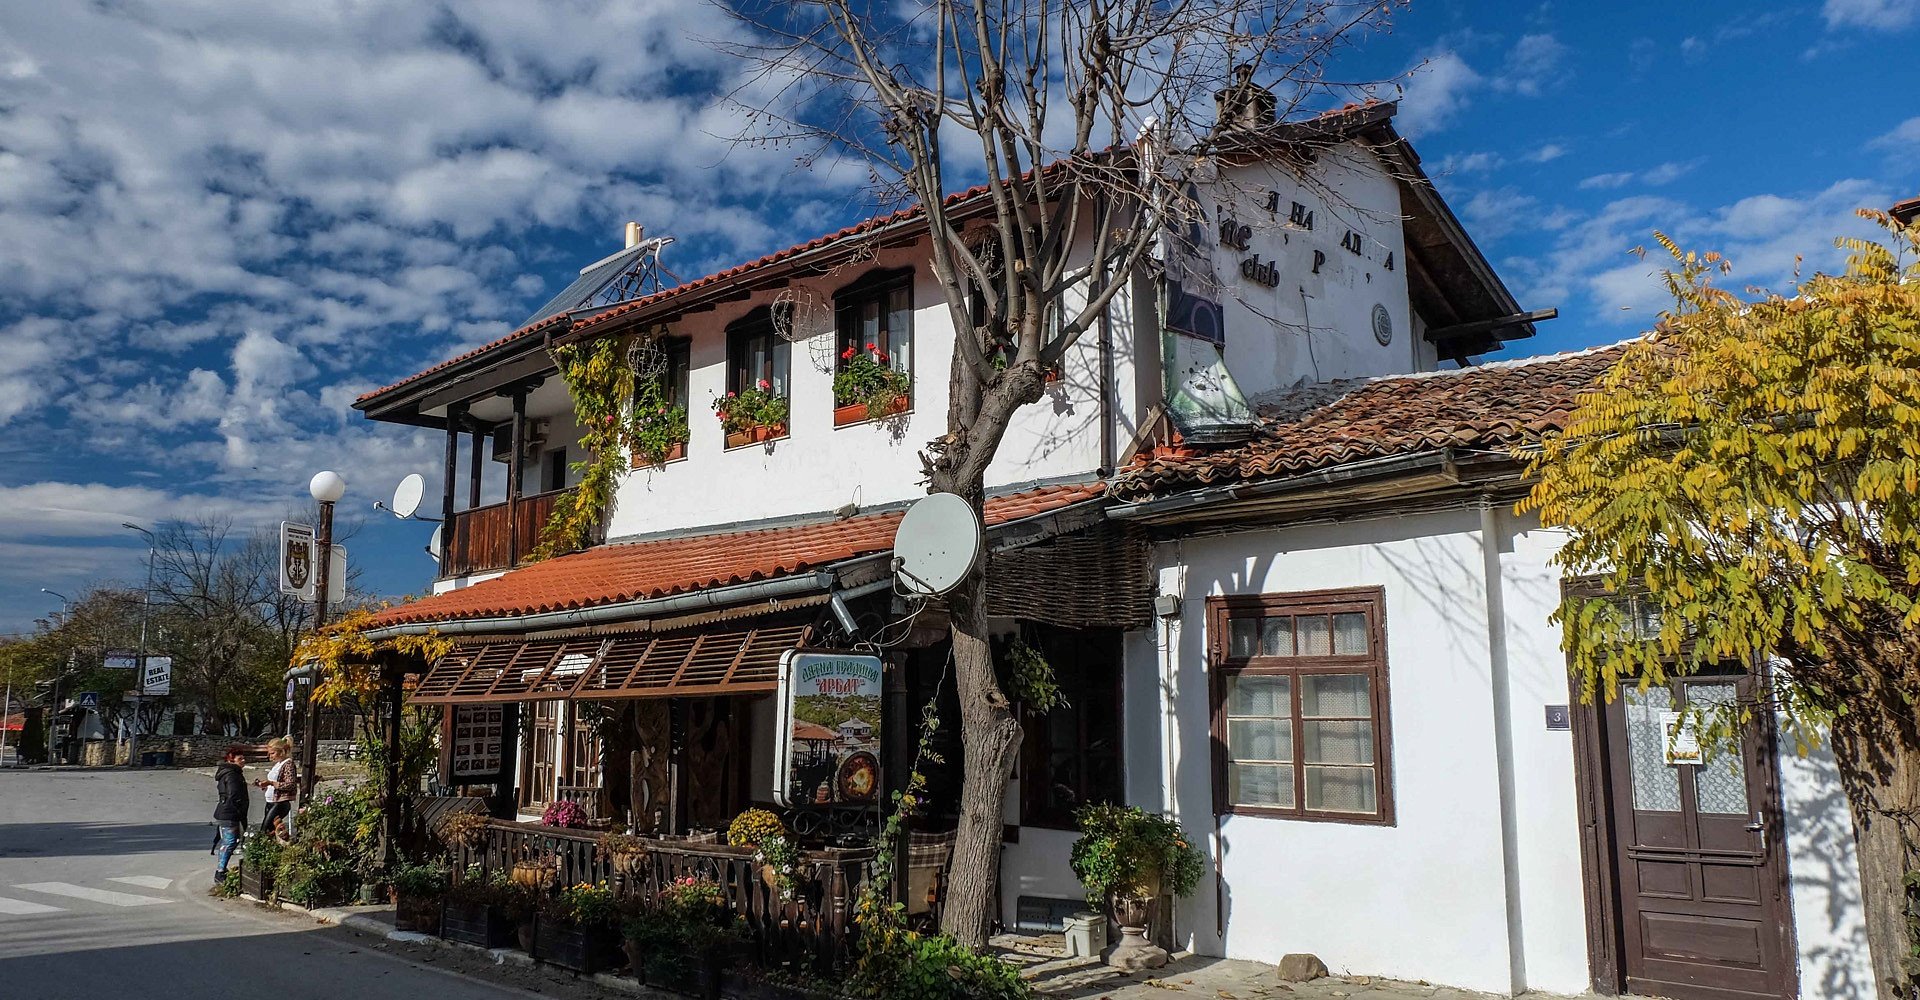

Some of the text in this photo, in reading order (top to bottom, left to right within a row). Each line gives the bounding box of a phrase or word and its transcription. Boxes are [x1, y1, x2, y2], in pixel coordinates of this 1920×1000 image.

[1242, 253, 1280, 288] club
[148, 666, 165, 676] REAL
[802, 660, 879, 683] ЛЯТНА ГРАДИНА
[146, 673, 170, 685] ESTATE
[1553, 712, 1561, 723] 3
